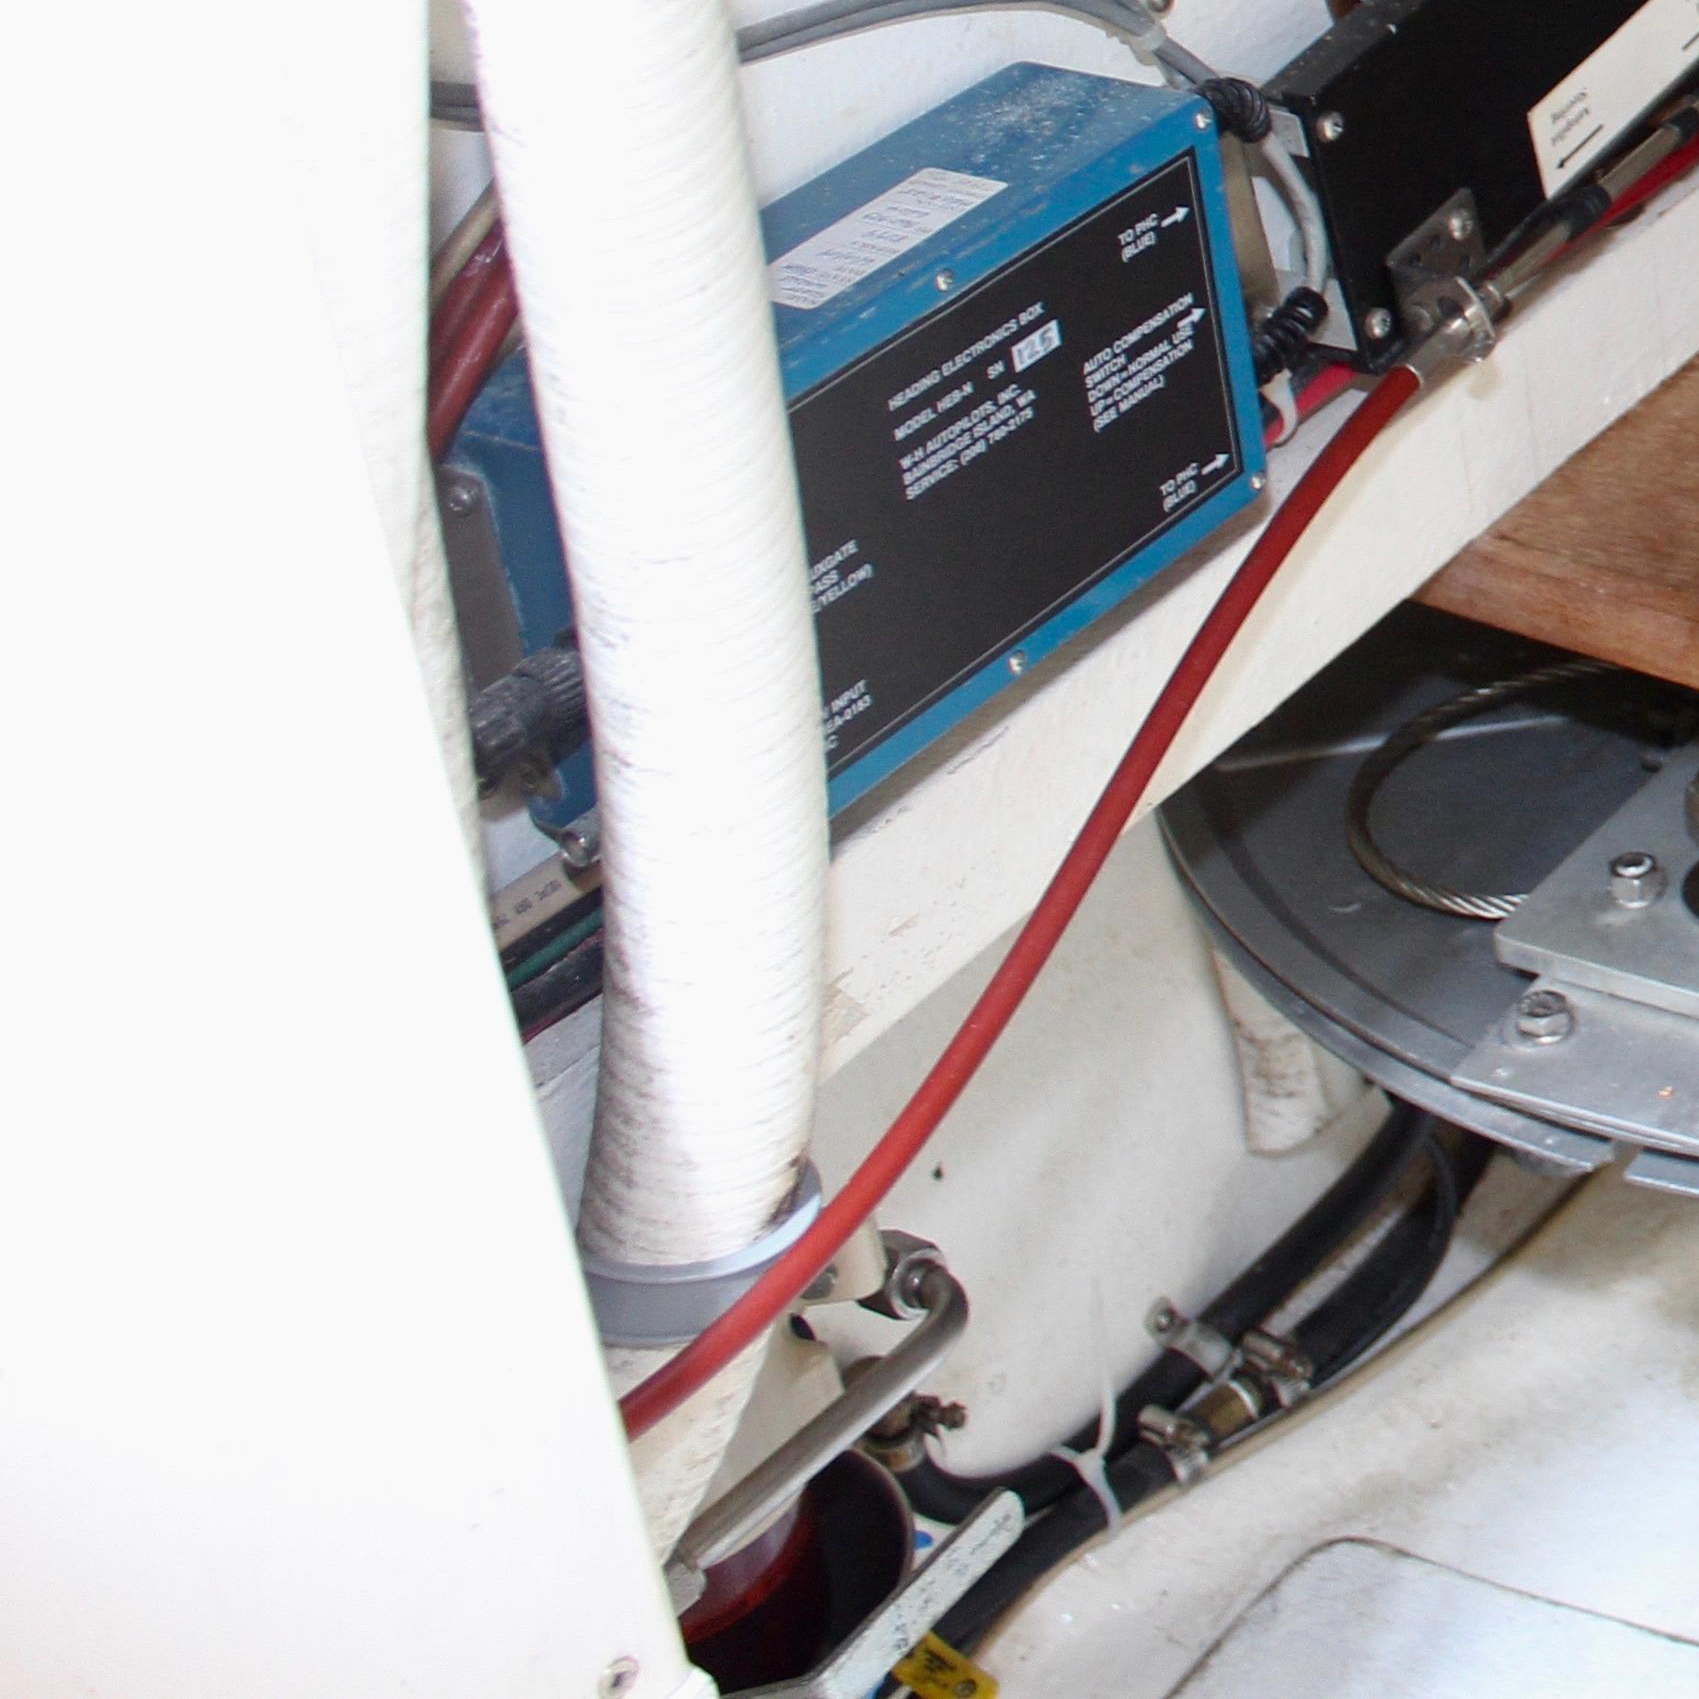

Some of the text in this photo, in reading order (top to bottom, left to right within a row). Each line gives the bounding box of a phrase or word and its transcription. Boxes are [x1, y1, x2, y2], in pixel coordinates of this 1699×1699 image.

[1117, 228, 1134, 246] TO
[1121, 231, 1155, 263] (BLUE)
[888, 301, 1045, 411] HEADING ELECTRONICS BOX
[1083, 292, 1194, 375] AUTO COMPENSATION
[1088, 371, 1121, 403] DOWN
[1127, 339, 1173, 376] NORMAL
[1171, 322, 1195, 344] USE
[1085, 353, 1127, 389] SWITCH
[1113, 338, 1194, 401] COMPENSATION
[894, 406, 938, 441] MODEL
[900, 446, 925, 470] W-H
[997, 383, 1022, 406] INC.
[1093, 373, 1166, 433] (SEE MANUAL)
[902, 430, 975, 486] BAINBRIDGE
[1015, 389, 1037, 408] WA
[1160, 479, 1175, 496] TO
[1163, 480, 1196, 513] (BLUE)
